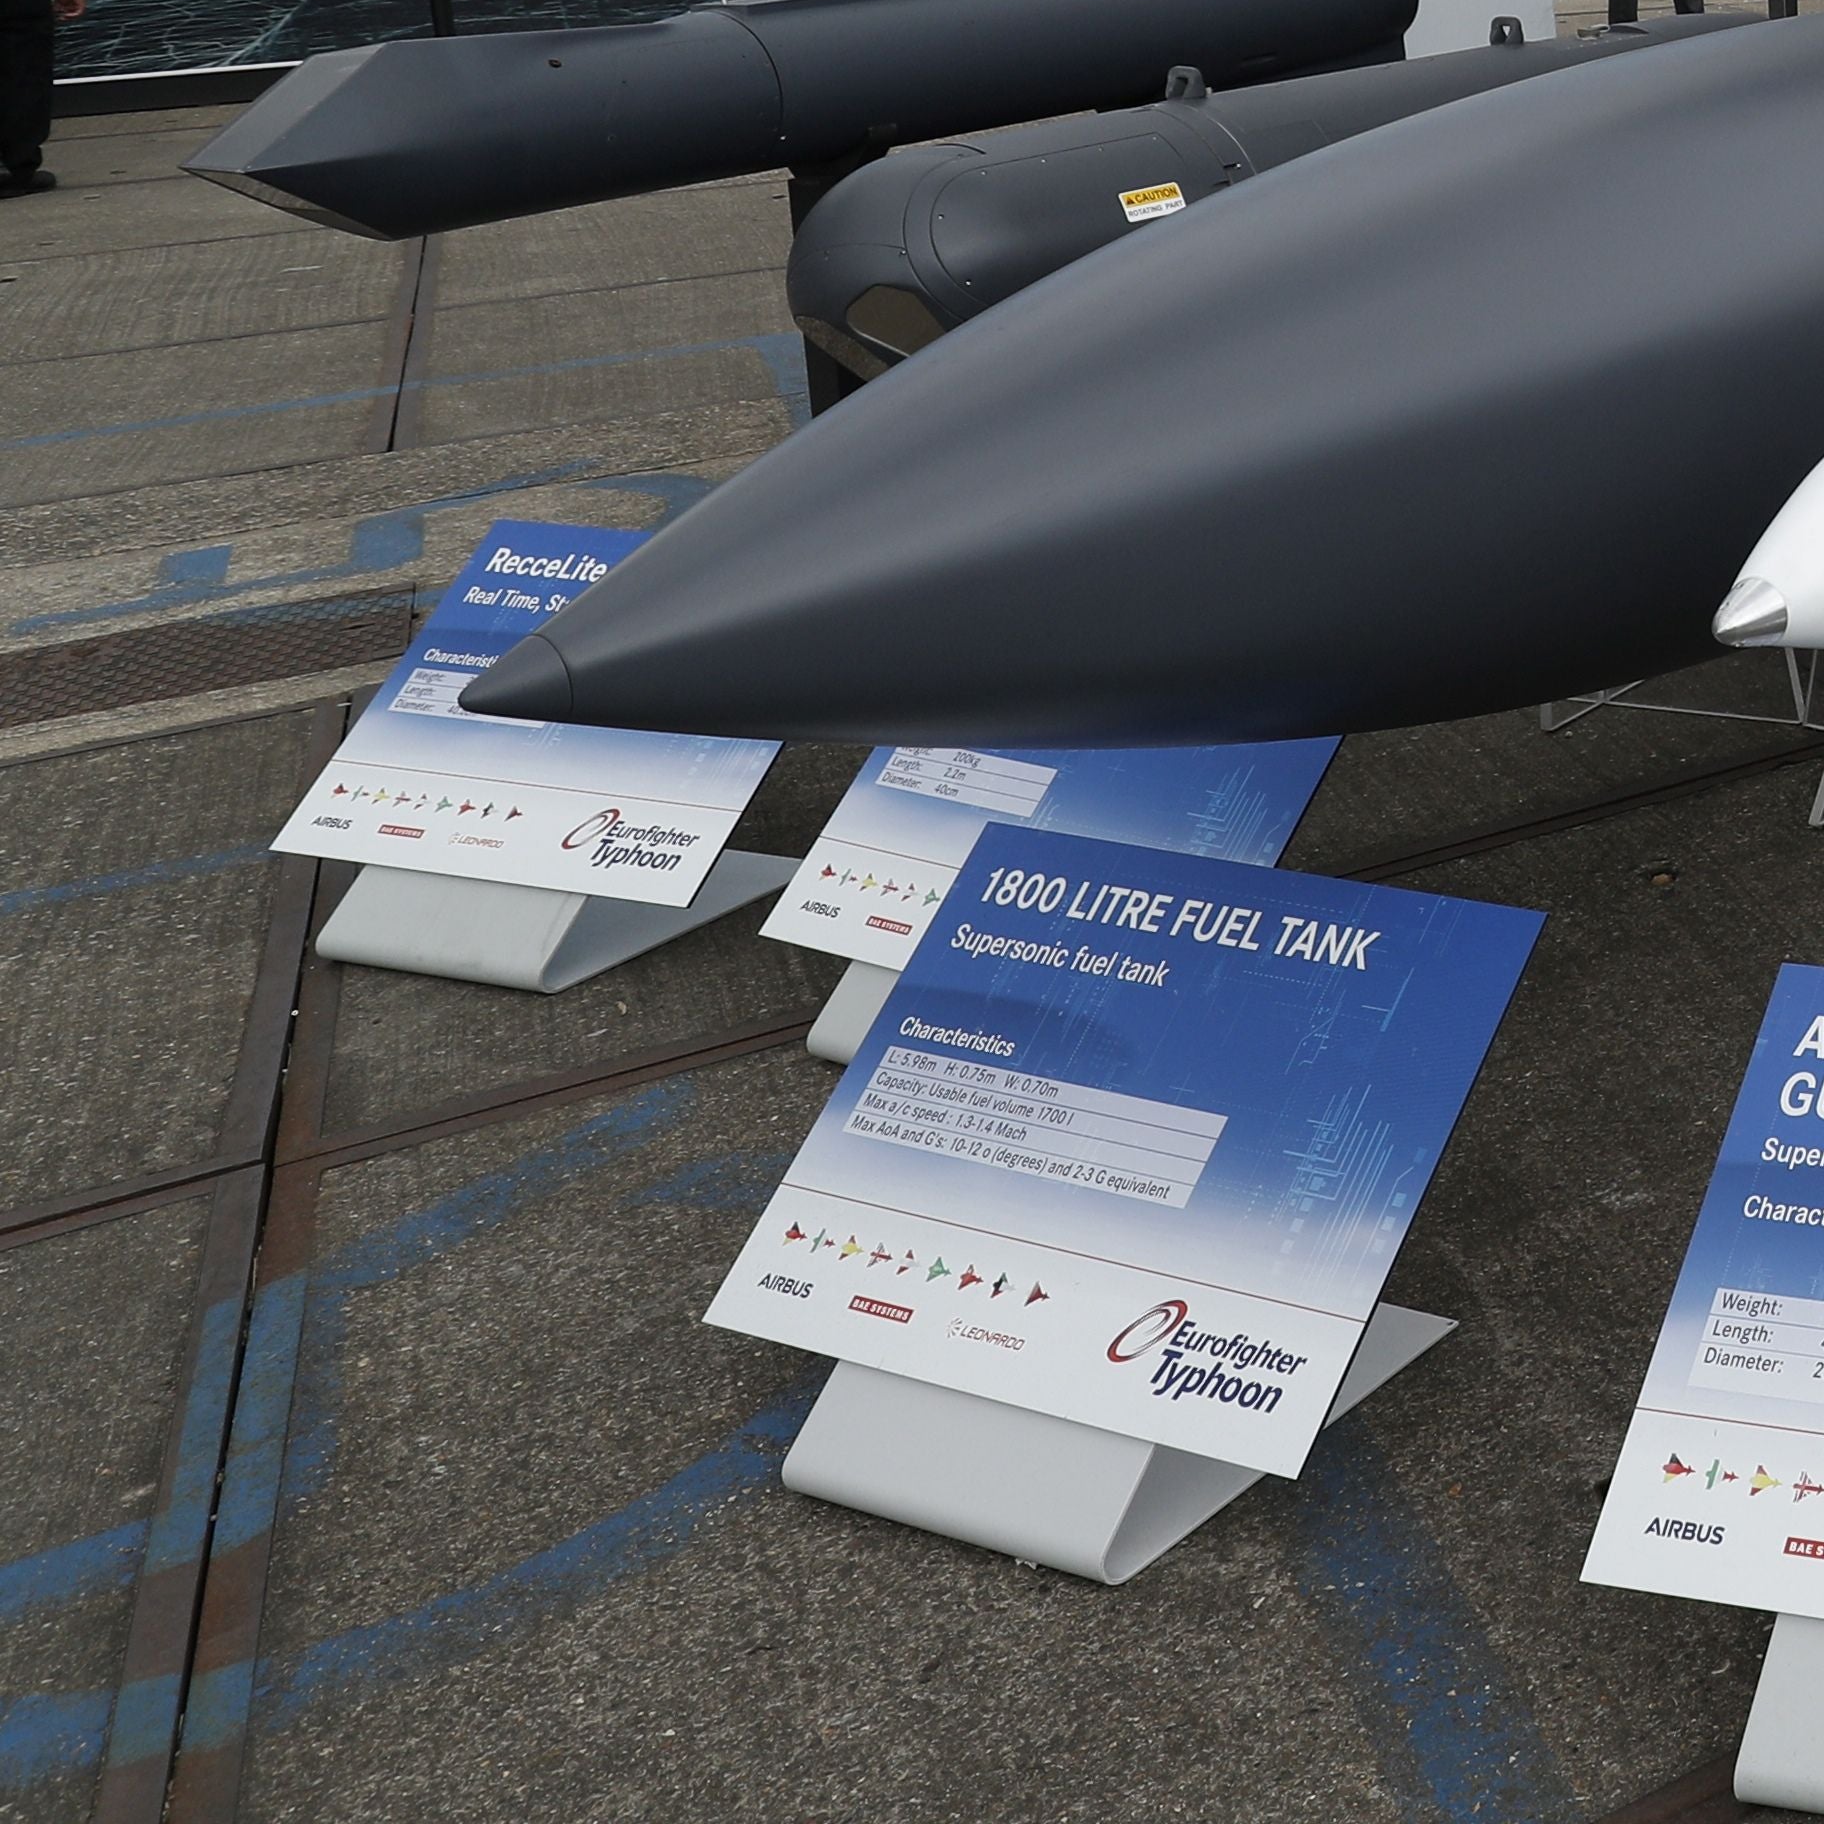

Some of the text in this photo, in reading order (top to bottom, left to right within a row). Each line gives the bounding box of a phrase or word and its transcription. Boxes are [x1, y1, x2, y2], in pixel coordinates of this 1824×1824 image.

[1128, 200, 1184, 217] ROTATING PART
[1135, 186, 1179, 203] CAUTION
[484, 547, 608, 583] RecceLite
[462, 586, 540, 614] Real Time,
[605, 817, 700, 847] Eurofighter
[591, 838, 682, 871] Typhoon
[981, 867, 1381, 970] 1800 LITRE FUEL TANK
[951, 923, 1069, 968] Supersonic
[1070, 945, 1119, 977] fuel
[1117, 956, 1170, 987] tank
[899, 1016, 1016, 1057] Characteristics
[887, 1049, 1059, 1098] L: 5.98m H: 0.75m W: 0.70m
[876, 1071, 928, 1097] Capacity:
[928, 1082, 968, 1103] Usable
[967, 1090, 994, 1108] fuel
[992, 1099, 1034, 1118] volume
[1037, 1106, 1067, 1125] 1700
[863, 1092, 889, 1110] Max
[888, 1101, 911, 1116] a/c
[911, 1106, 949, 1123] speed
[955, 1114, 995, 1134] 1.3-1.4
[994, 1121, 1027, 1141] Mach
[1722, 1292, 1783, 1318] Weight:
[1170, 1320, 1308, 1375] Eurofighter
[1712, 1319, 1774, 1345] Length:
[1703, 1346, 1784, 1373] Diameter:
[1150, 1348, 1283, 1414] Typhoon
[1644, 1517, 1725, 1545] AIRBUS
